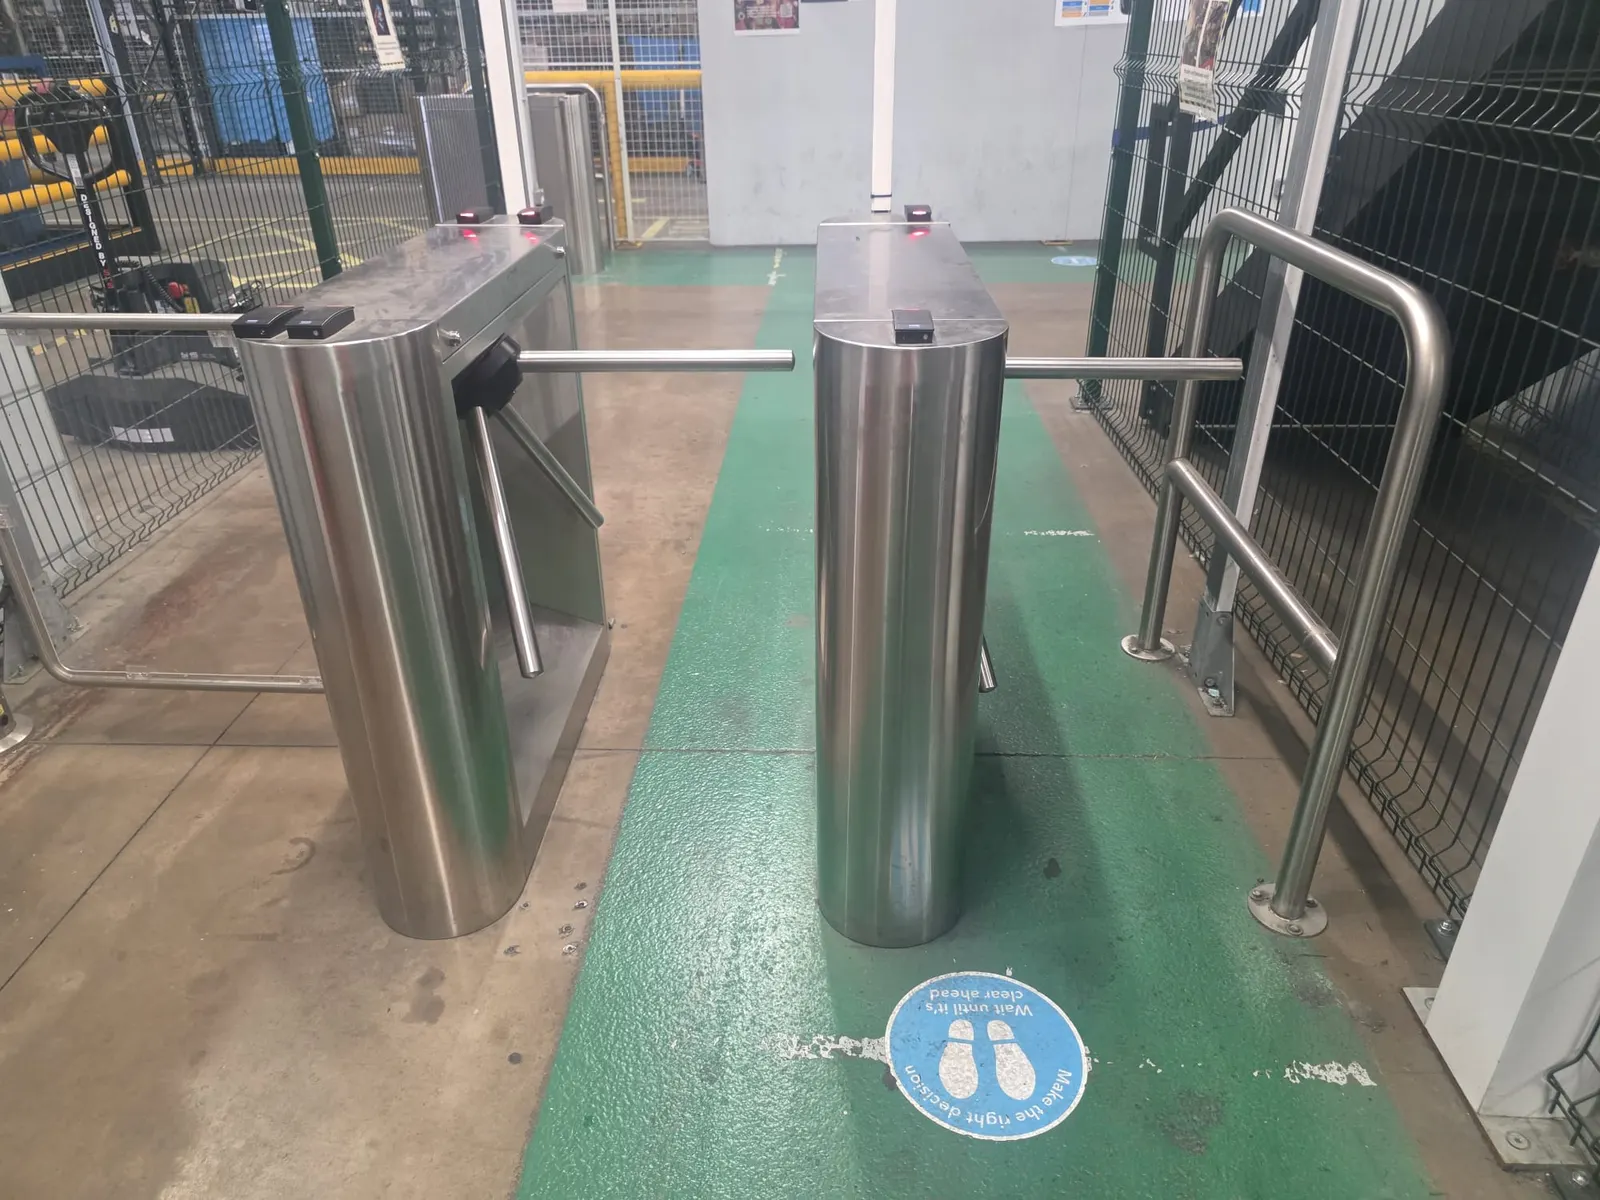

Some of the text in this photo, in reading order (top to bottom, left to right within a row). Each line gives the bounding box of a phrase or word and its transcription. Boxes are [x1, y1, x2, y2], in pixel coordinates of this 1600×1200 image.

[80, 194, 106, 267] DESIGNED BY
[926, 1003, 1033, 1017] Wait until it's
[929, 988, 1024, 1003] clear ahead
[904, 1065, 1072, 1128] Make the right decision
